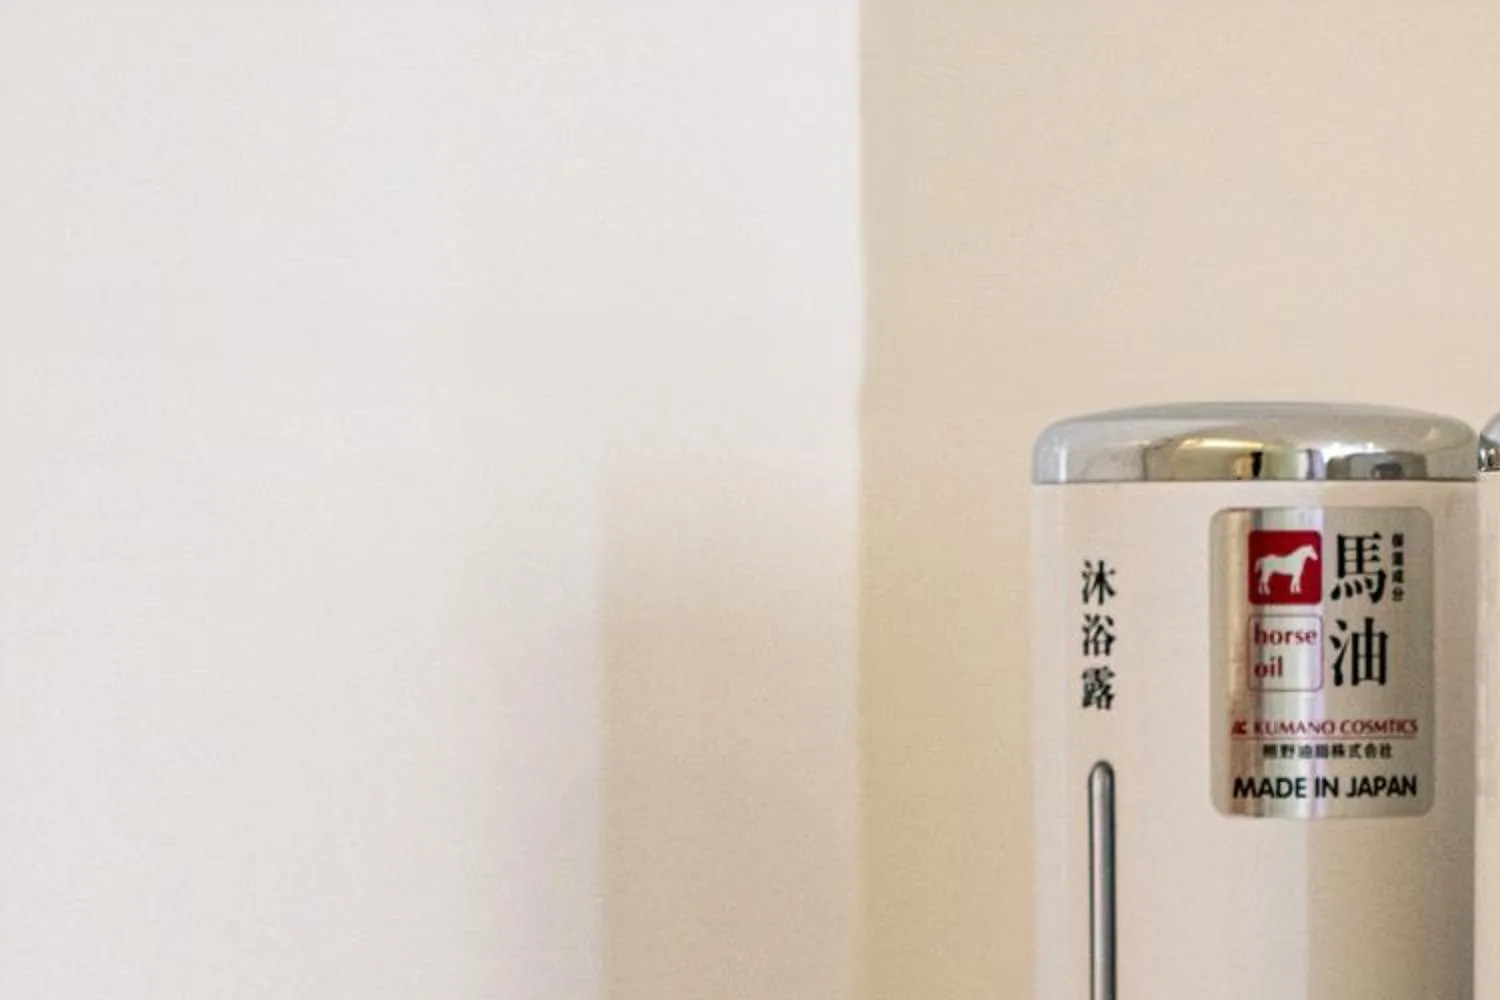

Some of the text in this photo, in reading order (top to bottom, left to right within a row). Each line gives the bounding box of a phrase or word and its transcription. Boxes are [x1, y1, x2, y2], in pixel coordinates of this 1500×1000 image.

[1329, 532, 1388, 687] 馬油
[1081, 559, 1116, 710] 沐浴露
[1254, 622, 1318, 646] horse
[1254, 656, 1284, 679] oil
[1254, 720, 1335, 735] KUMANO
[1233, 774, 1417, 799] MADE IN JAPAN
